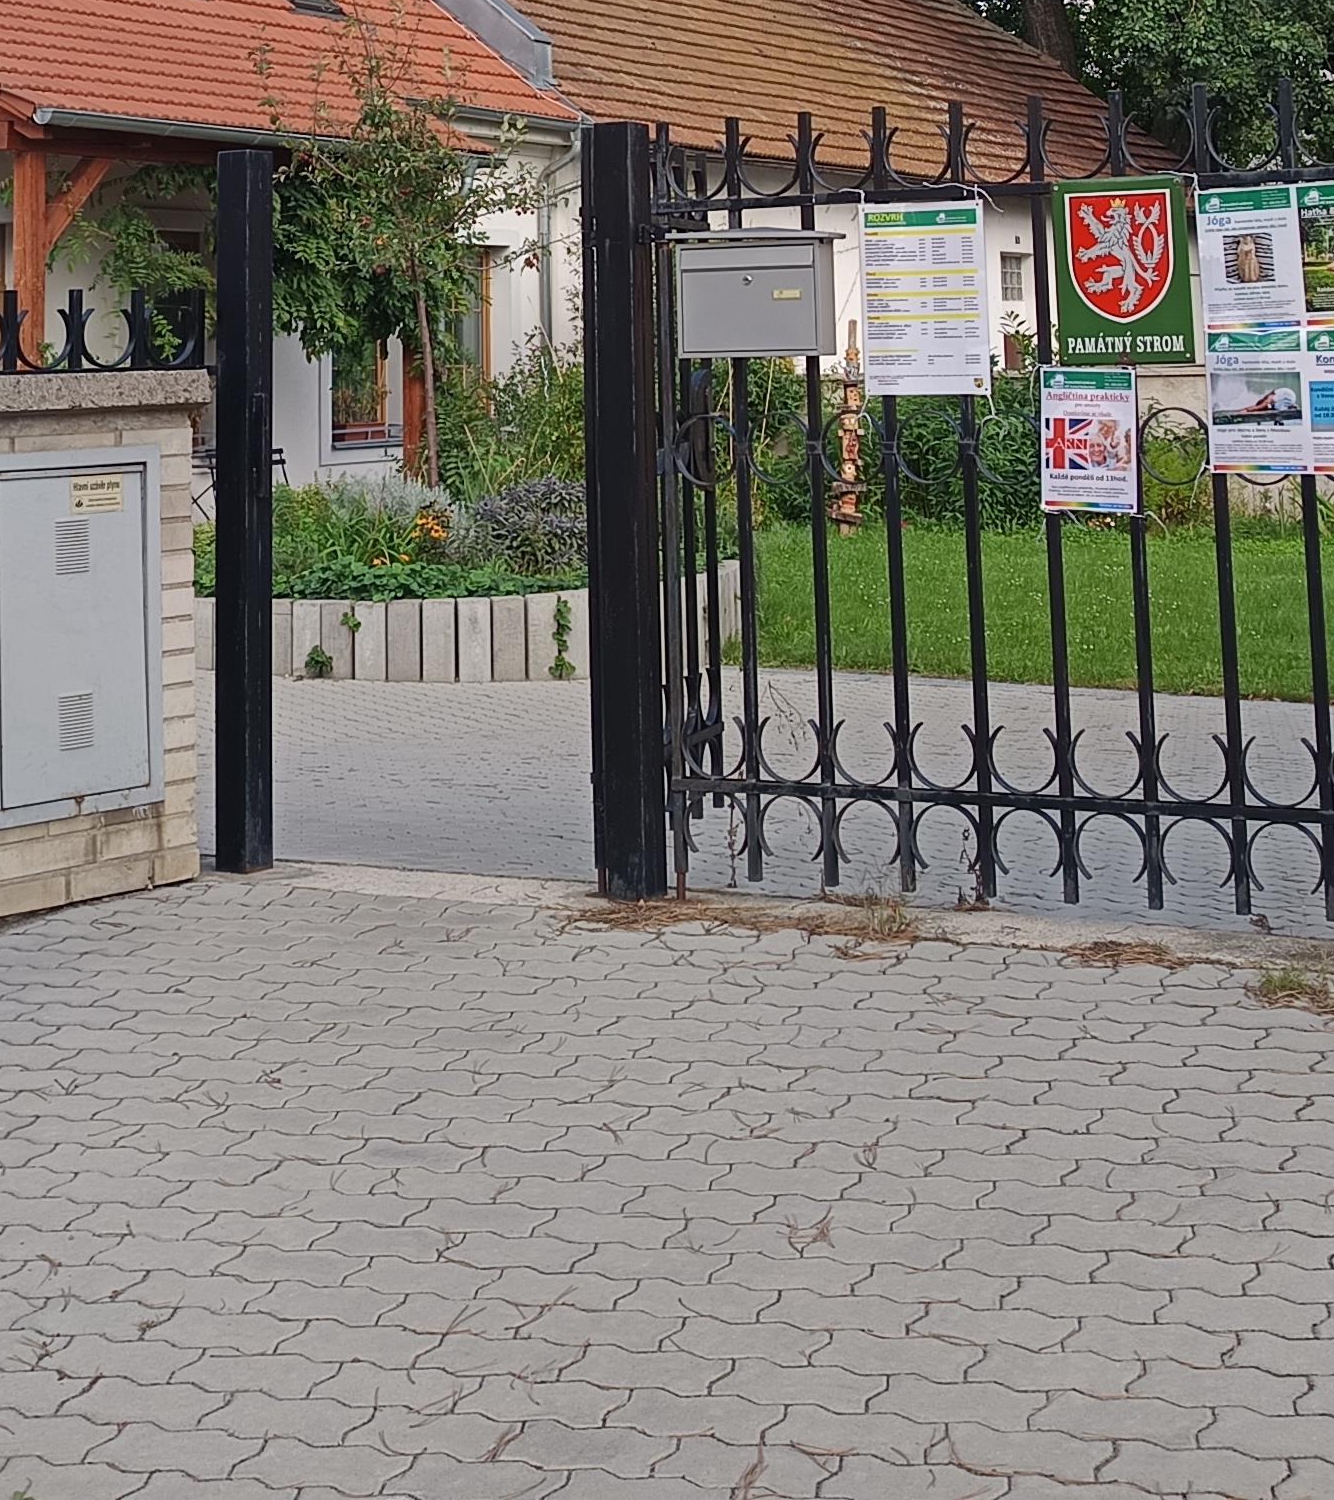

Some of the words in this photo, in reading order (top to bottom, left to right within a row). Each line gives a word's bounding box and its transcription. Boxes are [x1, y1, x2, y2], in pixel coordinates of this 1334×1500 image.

[867, 213, 904, 221] ROZVRH
[1207, 216, 1231, 227] Jóga
[1067, 331, 1133, 354] PAMÁTNÝ
[1136, 335, 1184, 353] STROM
[1215, 354, 1239, 367] Jóga
[1046, 391, 1088, 402] Angličtina
[1090, 392, 1130, 403] prakticky
